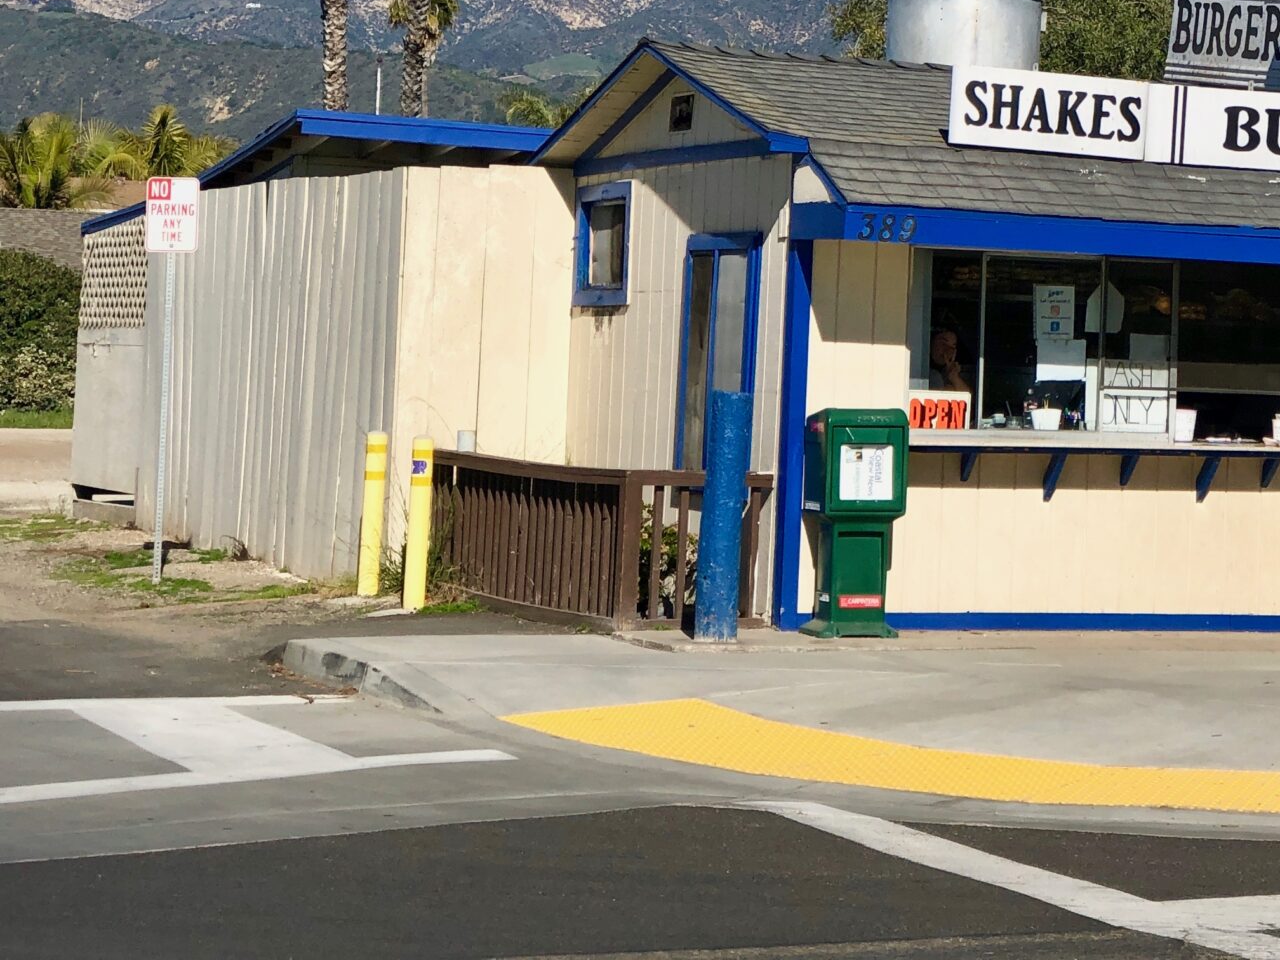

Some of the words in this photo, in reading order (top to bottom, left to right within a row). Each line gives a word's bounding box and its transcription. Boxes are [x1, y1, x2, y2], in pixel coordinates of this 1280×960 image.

[963, 79, 1142, 142] SHAKES
[151, 180, 169, 198] NO
[151, 203, 195, 216] PARKING
[162, 218, 182, 229] ANY
[162, 231, 182, 242] TIME
[858, 213, 917, 242] 389
[1104, 361, 1153, 388] ASH
[909, 398, 967, 429] OPEN
[874, 449, 884, 483] Coastal
